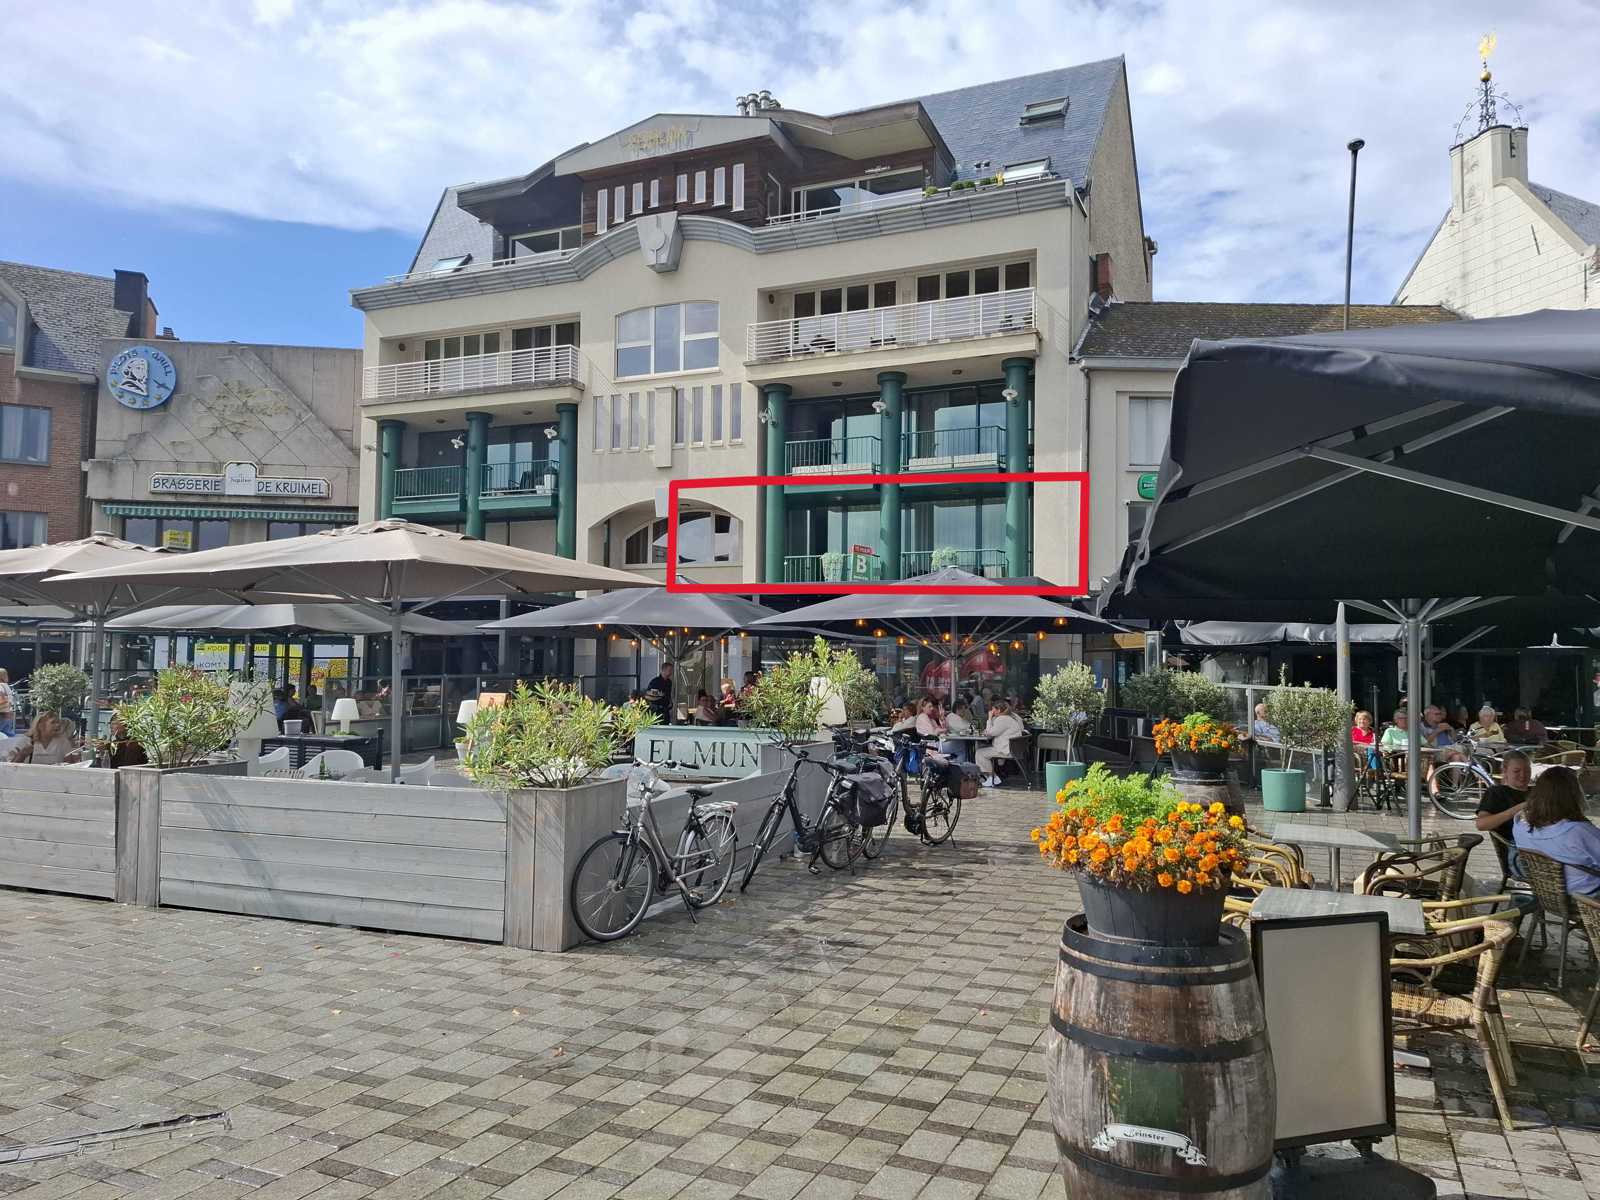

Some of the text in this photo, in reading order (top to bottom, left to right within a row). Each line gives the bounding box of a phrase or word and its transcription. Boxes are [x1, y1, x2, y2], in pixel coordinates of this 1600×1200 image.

[152, 478, 325, 494] BRASSERIE DE KRUIMEL
